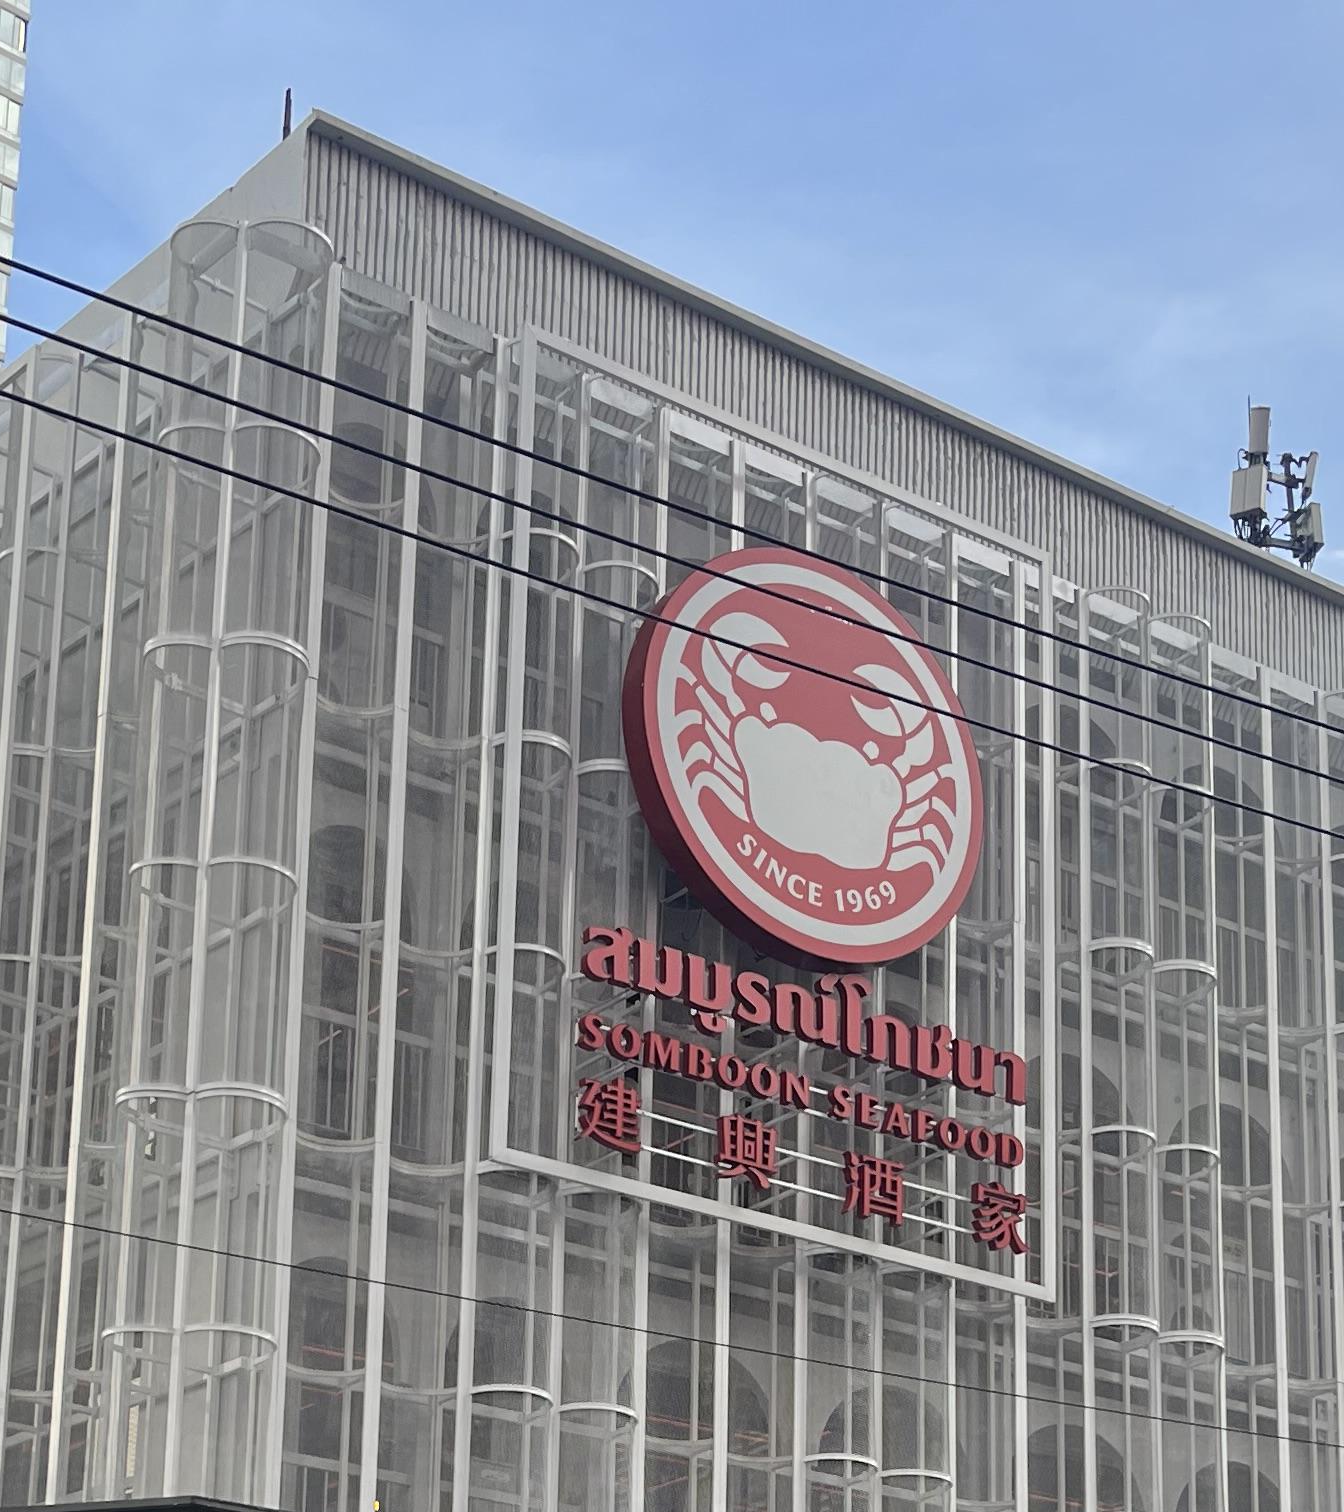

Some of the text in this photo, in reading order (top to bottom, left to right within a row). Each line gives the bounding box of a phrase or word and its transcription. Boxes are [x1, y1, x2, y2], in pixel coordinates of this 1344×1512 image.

[737, 834, 896, 913] SINCE 1969
[578, 1013, 1024, 1168] SOMBOON SEAFOOD
[581, 926, 1026, 1105] สมบูรณ์โภชนา
[578, 1078, 1029, 1254] 建興酒家
